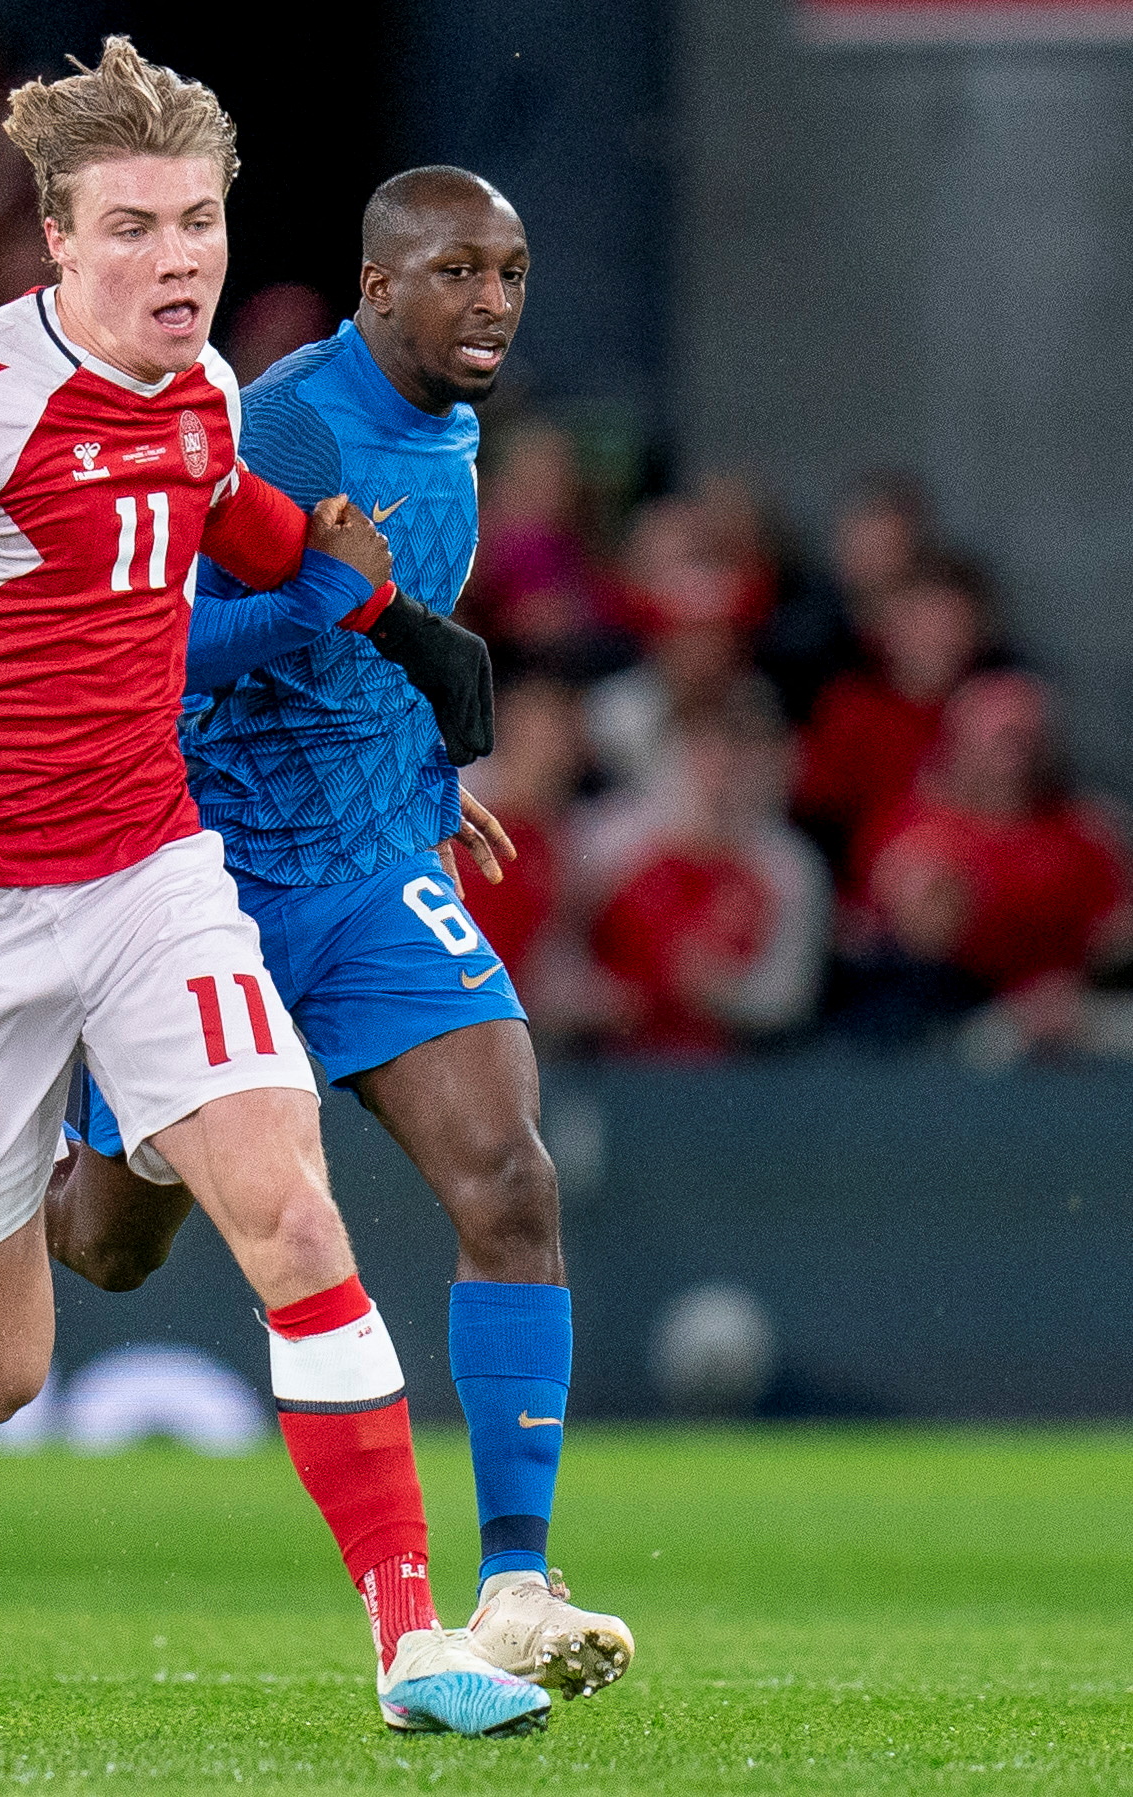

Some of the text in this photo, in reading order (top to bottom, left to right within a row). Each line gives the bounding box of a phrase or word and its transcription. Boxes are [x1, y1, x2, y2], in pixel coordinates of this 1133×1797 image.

[111, 491, 170, 591] 11
[403, 876, 478, 956] 6
[187, 973, 278, 1066] 11
